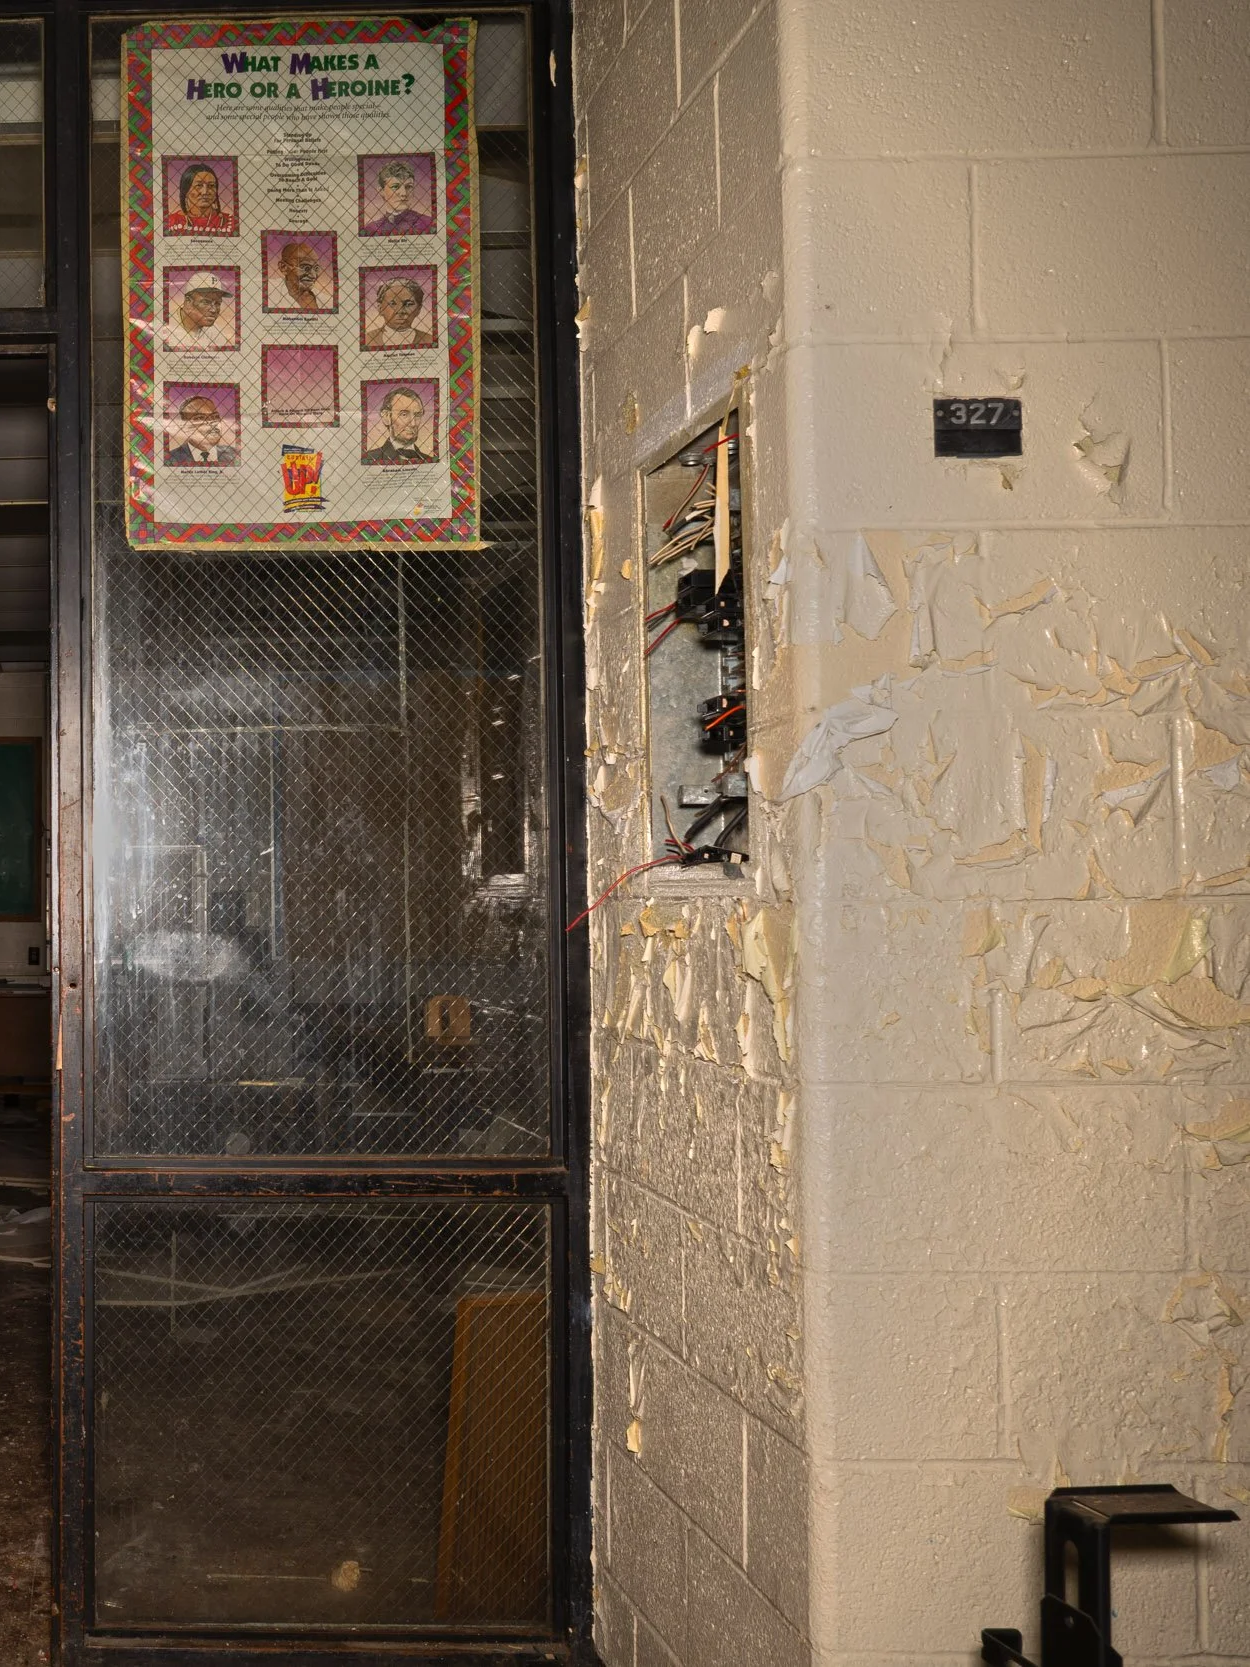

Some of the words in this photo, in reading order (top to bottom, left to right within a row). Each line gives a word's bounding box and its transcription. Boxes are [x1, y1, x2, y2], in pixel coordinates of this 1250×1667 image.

[221, 52, 281, 73] WHAT
[290, 53, 359, 74] MAKES
[364, 54, 379, 70] A
[186, 79, 242, 100] HERO
[250, 80, 278, 98] OR
[285, 82, 301, 99] A
[311, 73, 415, 100] HEROINE?
[950, 402, 1005, 425] 327
[281, 451, 322, 495] UP!
